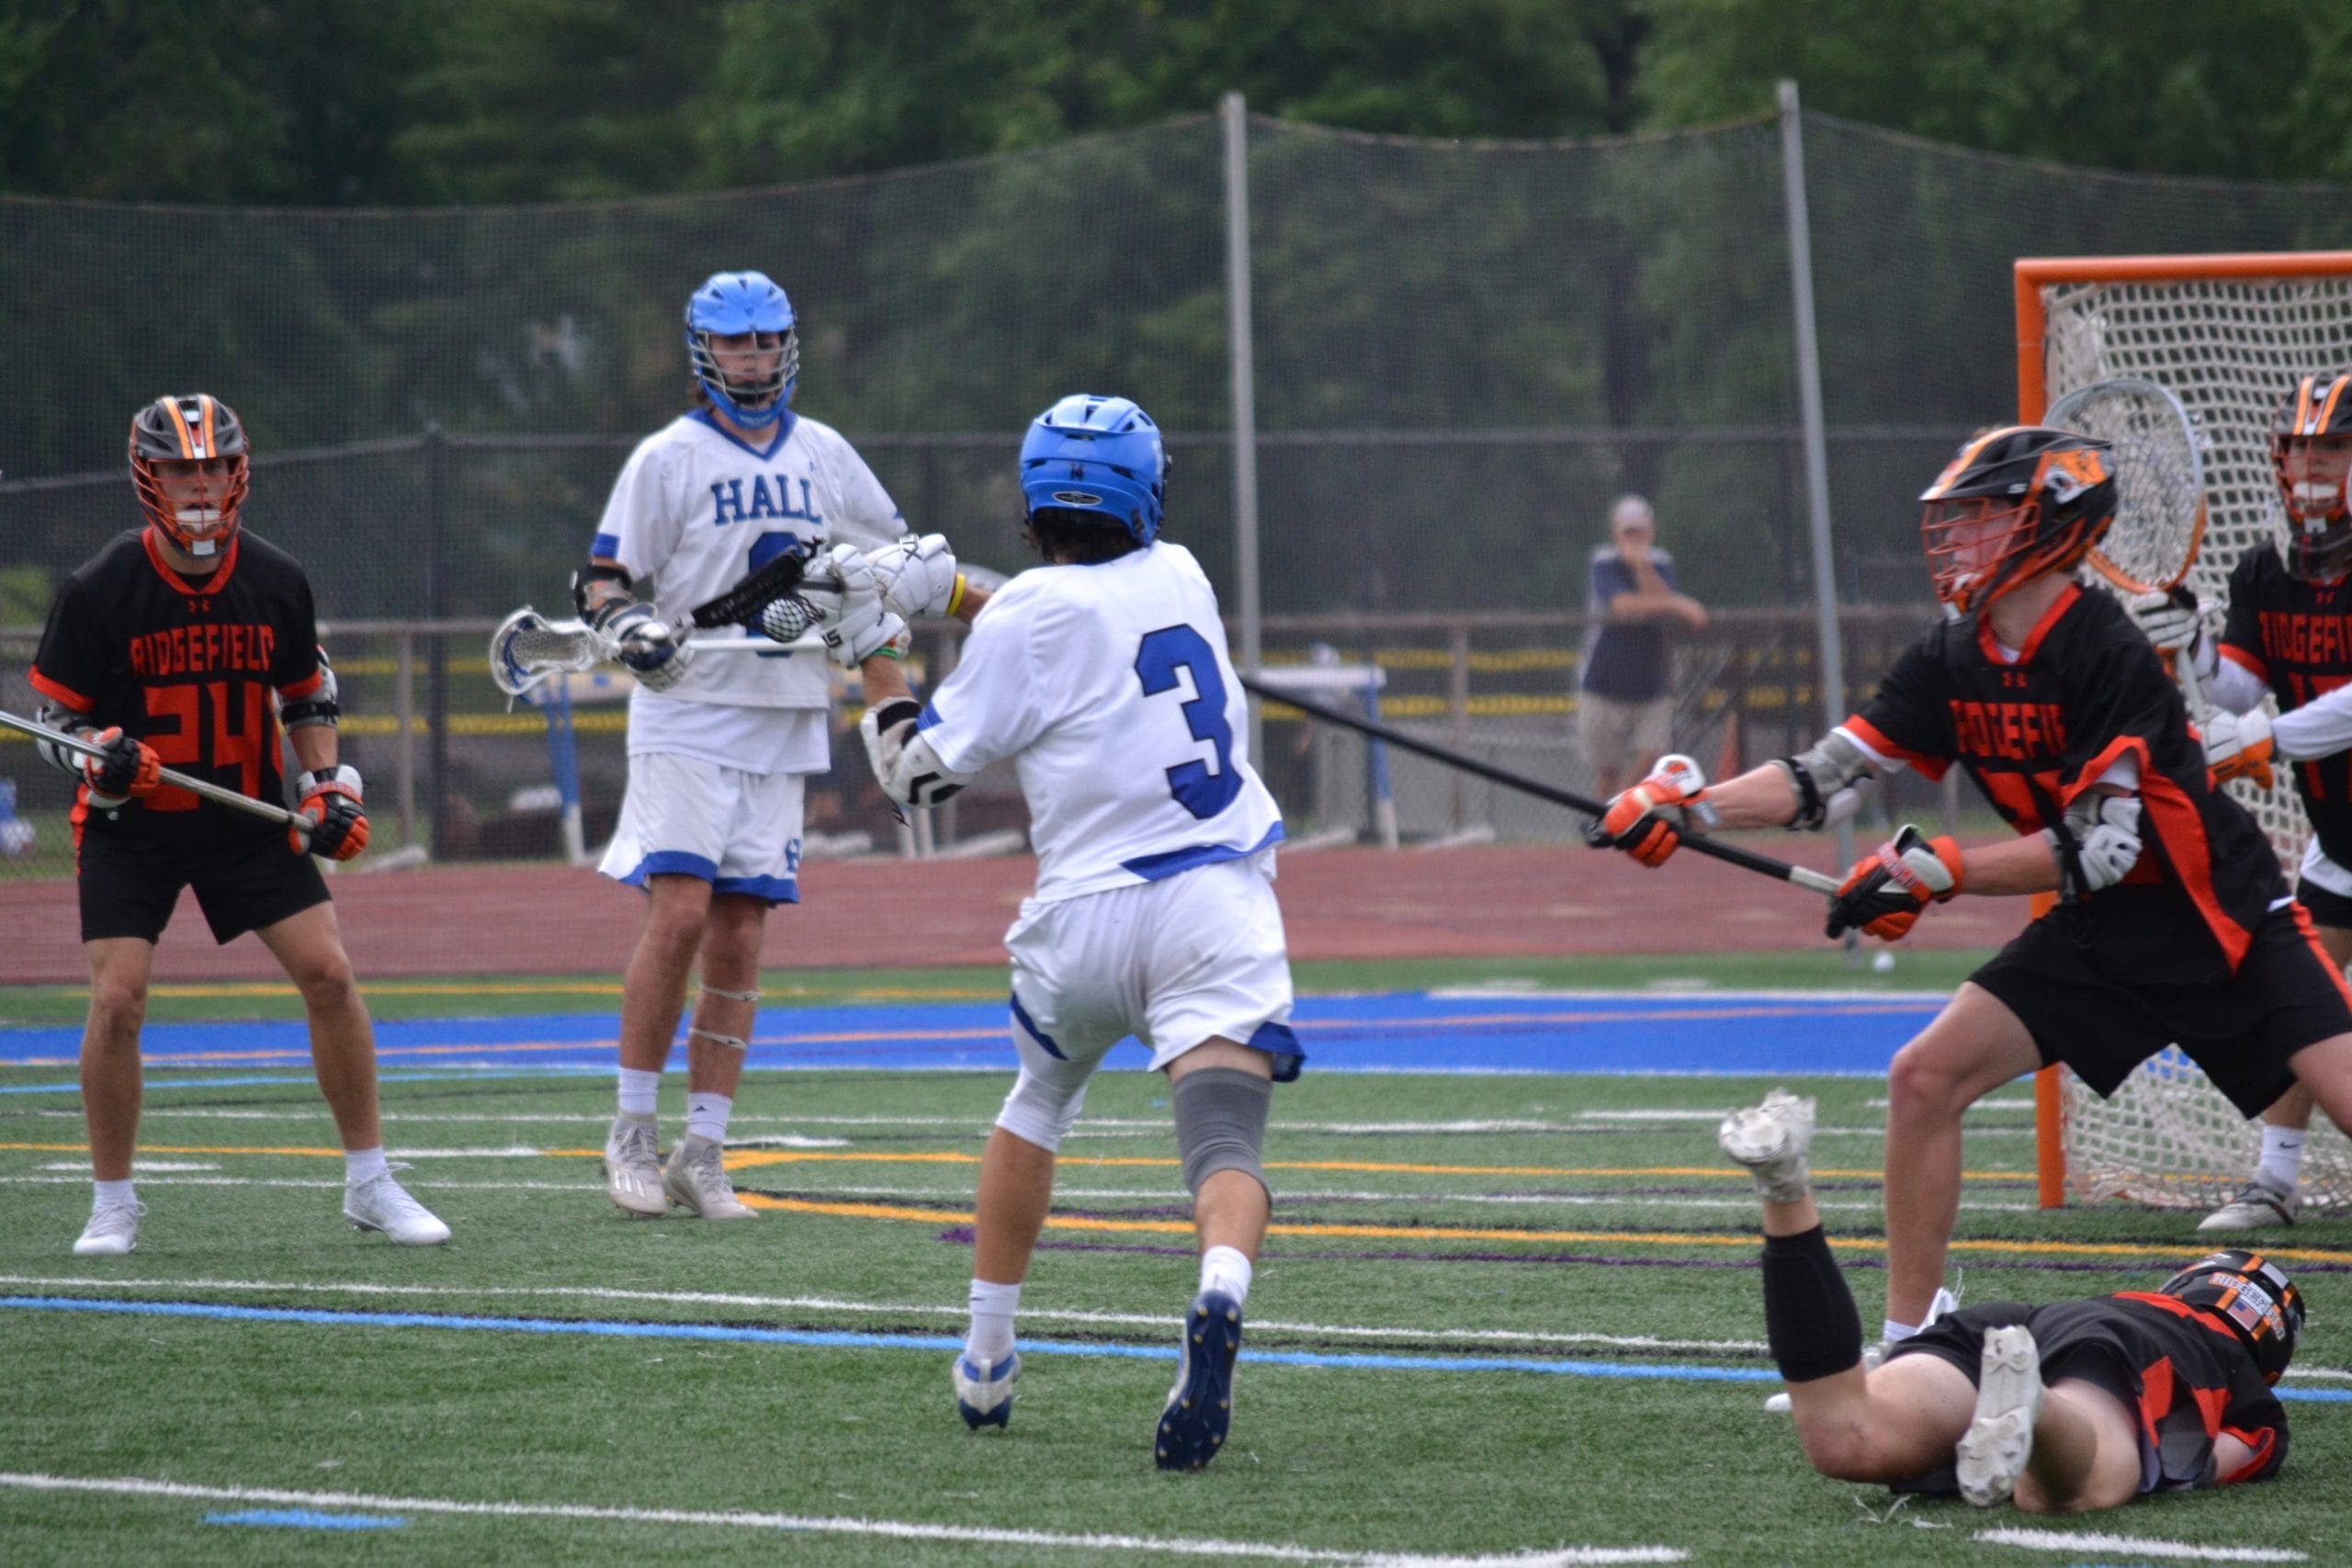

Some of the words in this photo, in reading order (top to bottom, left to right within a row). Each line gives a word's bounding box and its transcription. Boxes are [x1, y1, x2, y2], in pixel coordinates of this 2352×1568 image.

[710, 473, 823, 526] HALL
[129, 624, 275, 676] RIDGEFIELD
[141, 680, 264, 812] 24
[1134, 623, 1244, 819] 3
